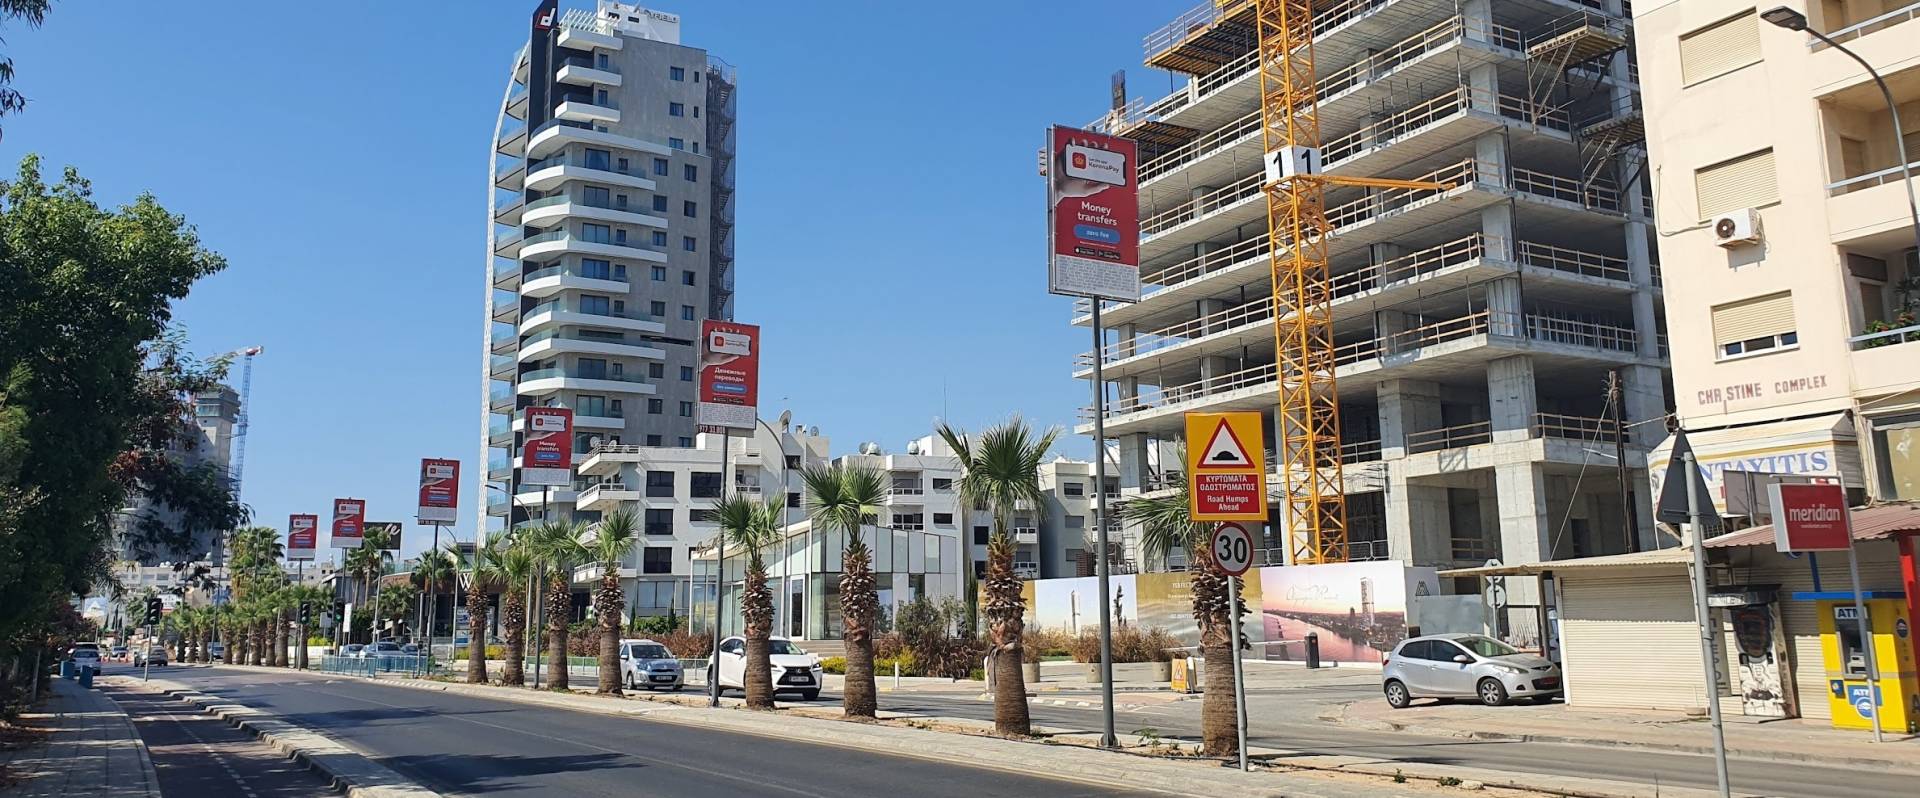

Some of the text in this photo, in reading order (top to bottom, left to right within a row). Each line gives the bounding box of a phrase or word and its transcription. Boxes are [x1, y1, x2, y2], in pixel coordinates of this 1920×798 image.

[1273, 151, 1284, 178] 1
[1301, 148, 1312, 175] 1
[1081, 201, 1112, 216] Money
[1077, 212, 1118, 226] transfers
[1774, 375, 1828, 394] COMPLEX
[1207, 495, 1249, 504] Road Humps
[1218, 503, 1240, 511] Ahead
[1788, 503, 1841, 521] meridian
[1218, 534, 1247, 564] 30
[1853, 688, 1869, 697] AT
